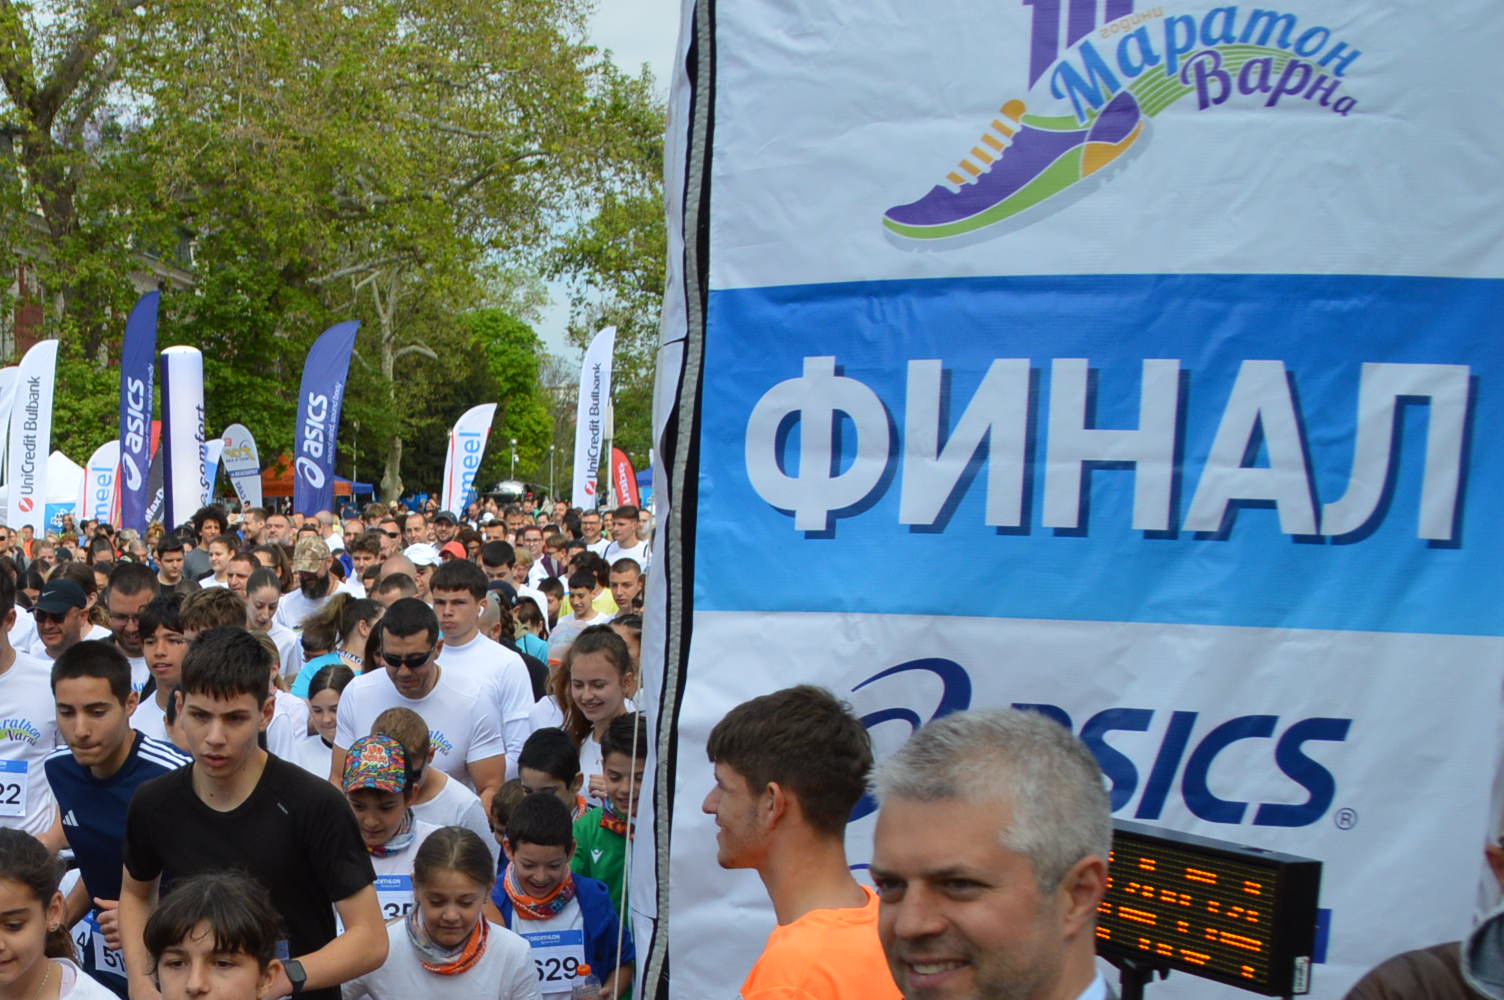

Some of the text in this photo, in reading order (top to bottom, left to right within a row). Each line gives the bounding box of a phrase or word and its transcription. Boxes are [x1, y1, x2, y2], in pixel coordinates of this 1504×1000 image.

[1050, 5, 1362, 127] Маратон
[1180, 50, 1359, 117] Варна
[21, 376, 40, 495] UniCredit Bulbank
[125, 376, 144, 454] asics
[303, 391, 328, 458] asics
[587, 362, 601, 479] UniCredit Bulbank
[744, 355, 1474, 543] ФИНАЛ
[1011, 703, 1353, 828] SICS
